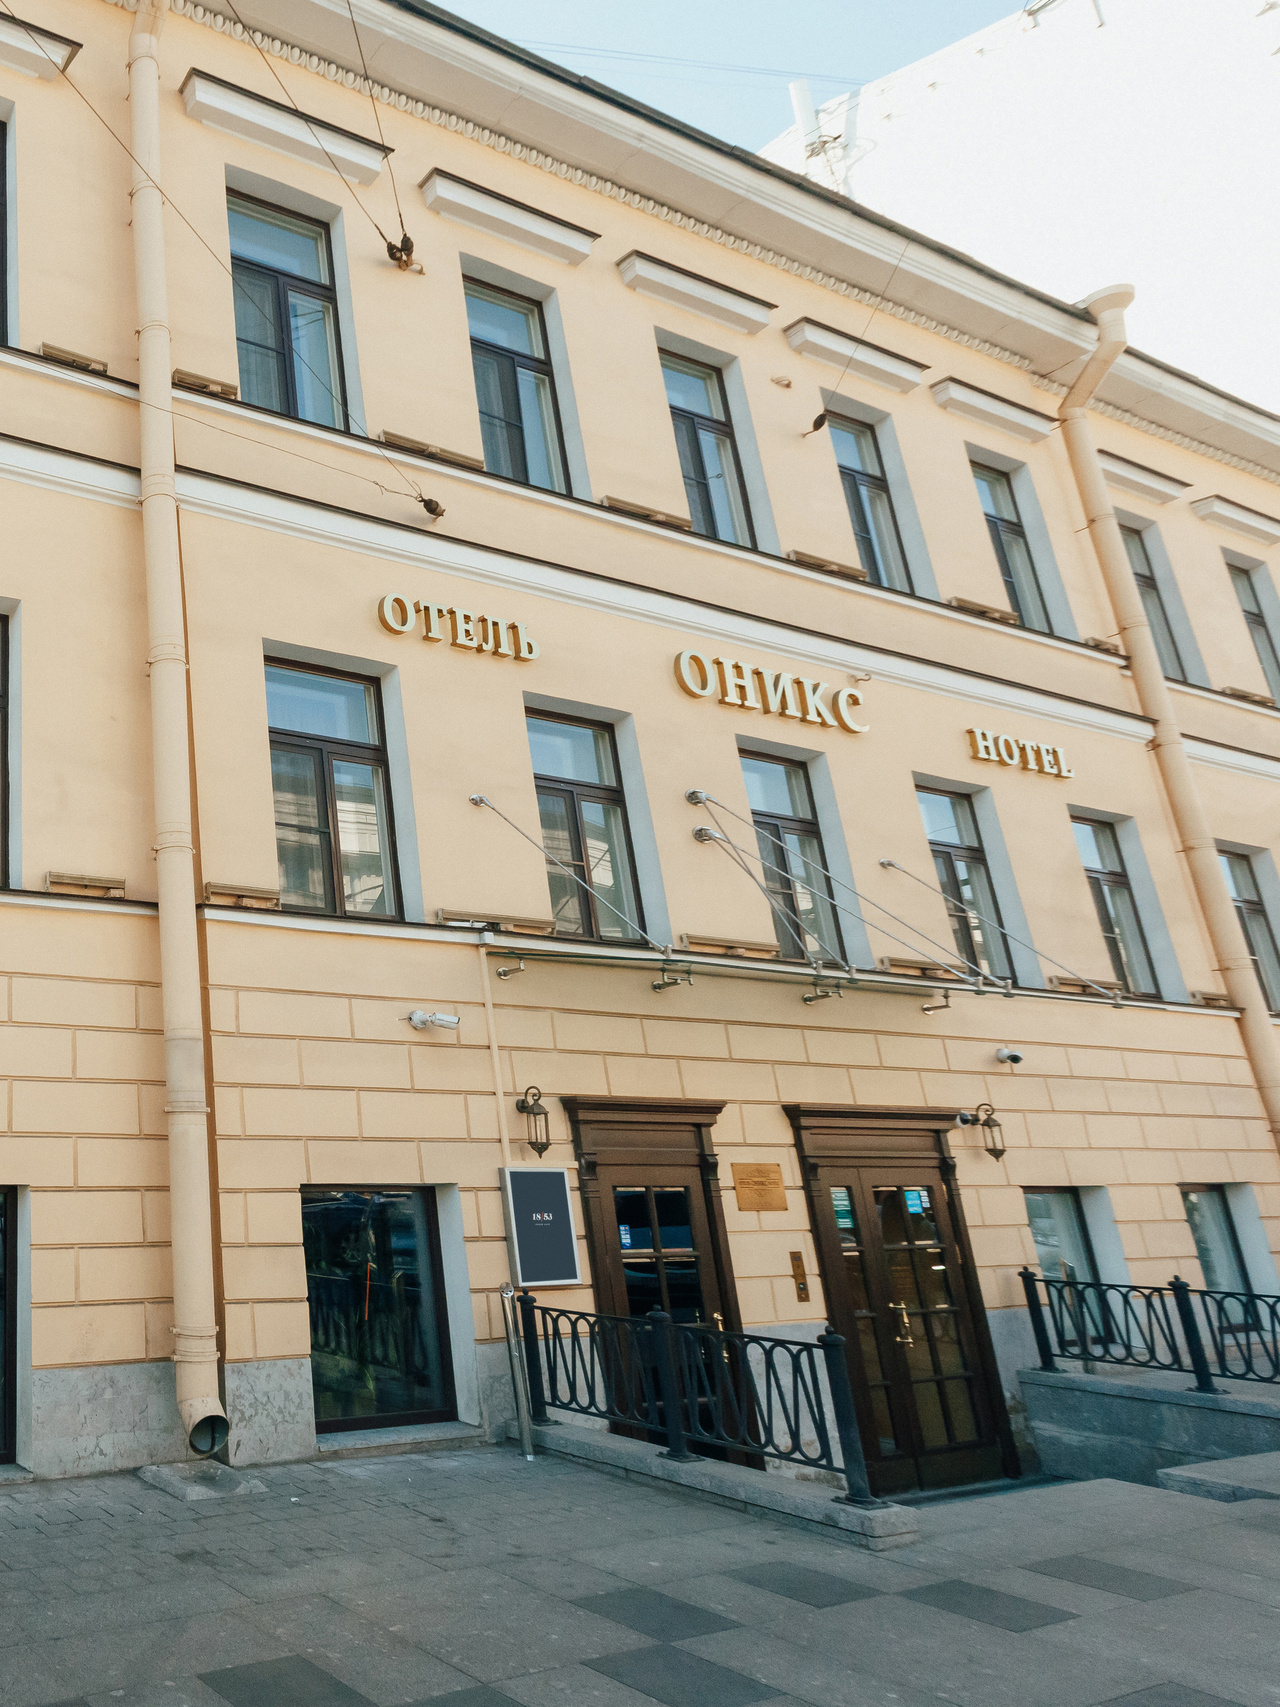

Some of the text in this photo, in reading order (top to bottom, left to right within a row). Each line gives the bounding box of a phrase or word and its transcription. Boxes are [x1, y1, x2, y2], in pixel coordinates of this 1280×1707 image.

[377, 592, 870, 734] ОТЕЛЬ ОНИКС
[967, 727, 1076, 779] HOTEL
[532, 1211, 553, 1222] 18/53
